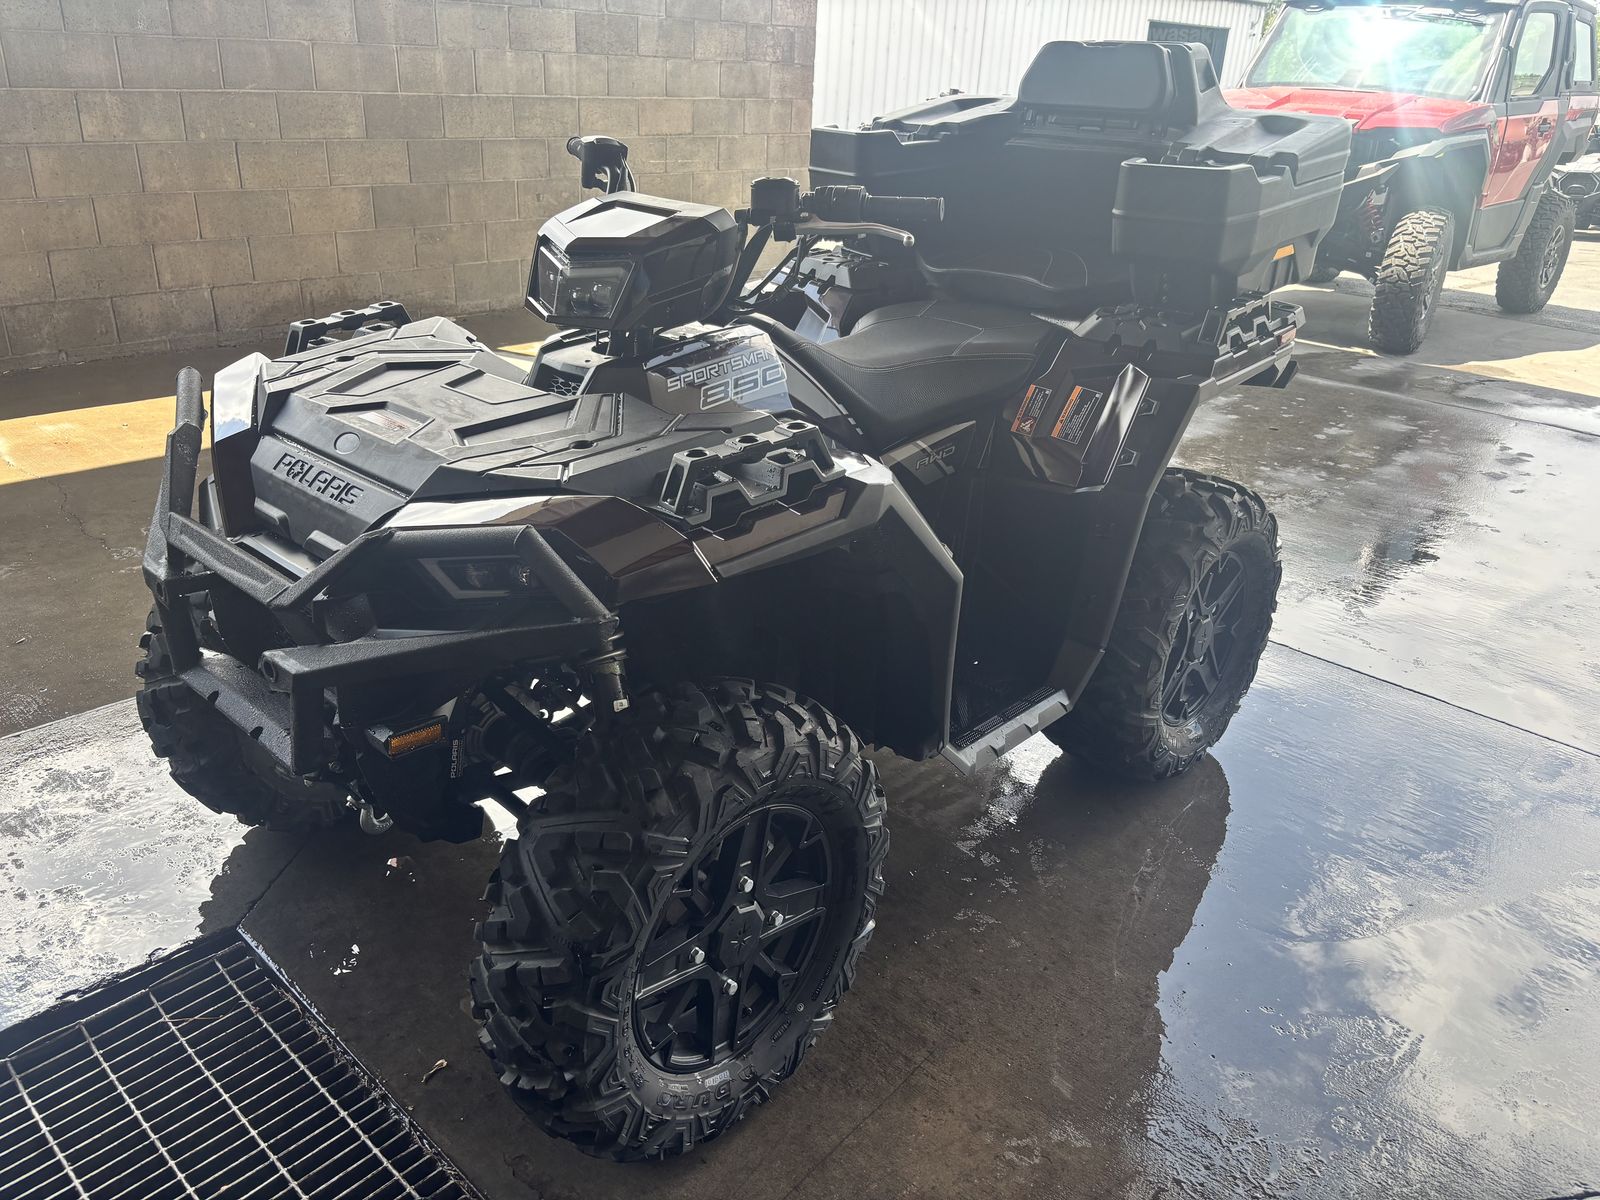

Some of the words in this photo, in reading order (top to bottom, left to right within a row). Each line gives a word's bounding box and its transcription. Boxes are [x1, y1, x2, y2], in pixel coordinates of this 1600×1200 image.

[700, 361, 787, 411] 850
[272, 452, 365, 505] POLARIS
[916, 445, 956, 470] AWD
[450, 739, 459, 779] POLARIS
